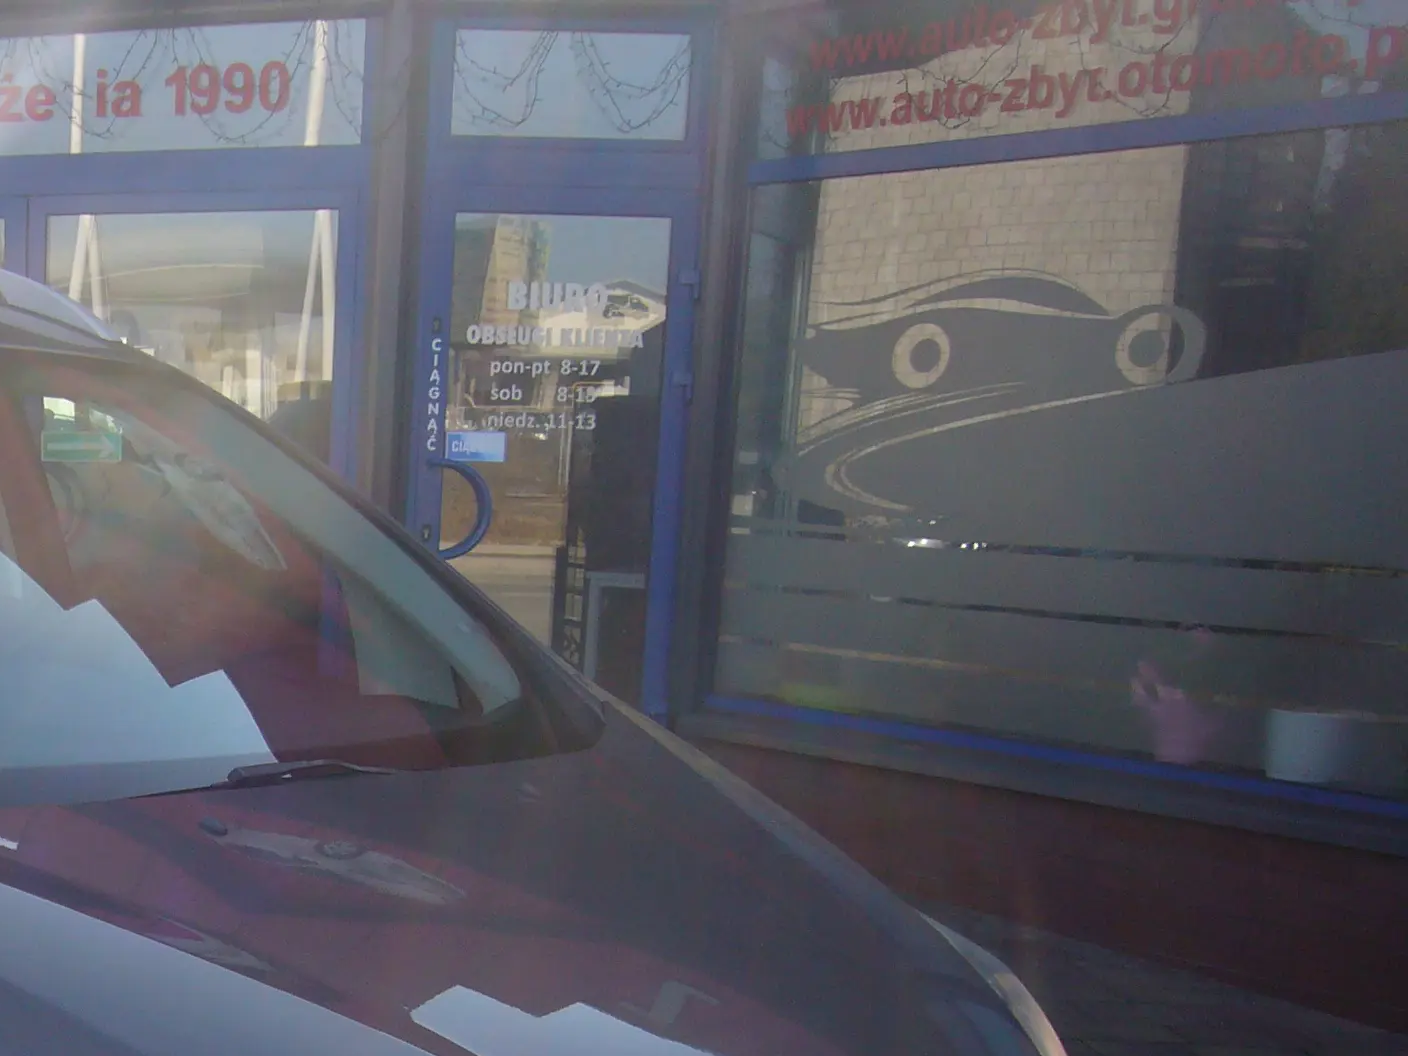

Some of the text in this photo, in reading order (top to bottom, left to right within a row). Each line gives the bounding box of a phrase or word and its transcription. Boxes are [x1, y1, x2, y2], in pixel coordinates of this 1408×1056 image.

[165, 60, 291, 117] 1990
[508, 280, 609, 312] BIURO
[489, 359, 601, 377] pon-pt 8-17
[426, 337, 443, 452] CIĄGNĄĆ
[490, 384, 523, 401] sob
[487, 411, 597, 431] niedz. 11-13
